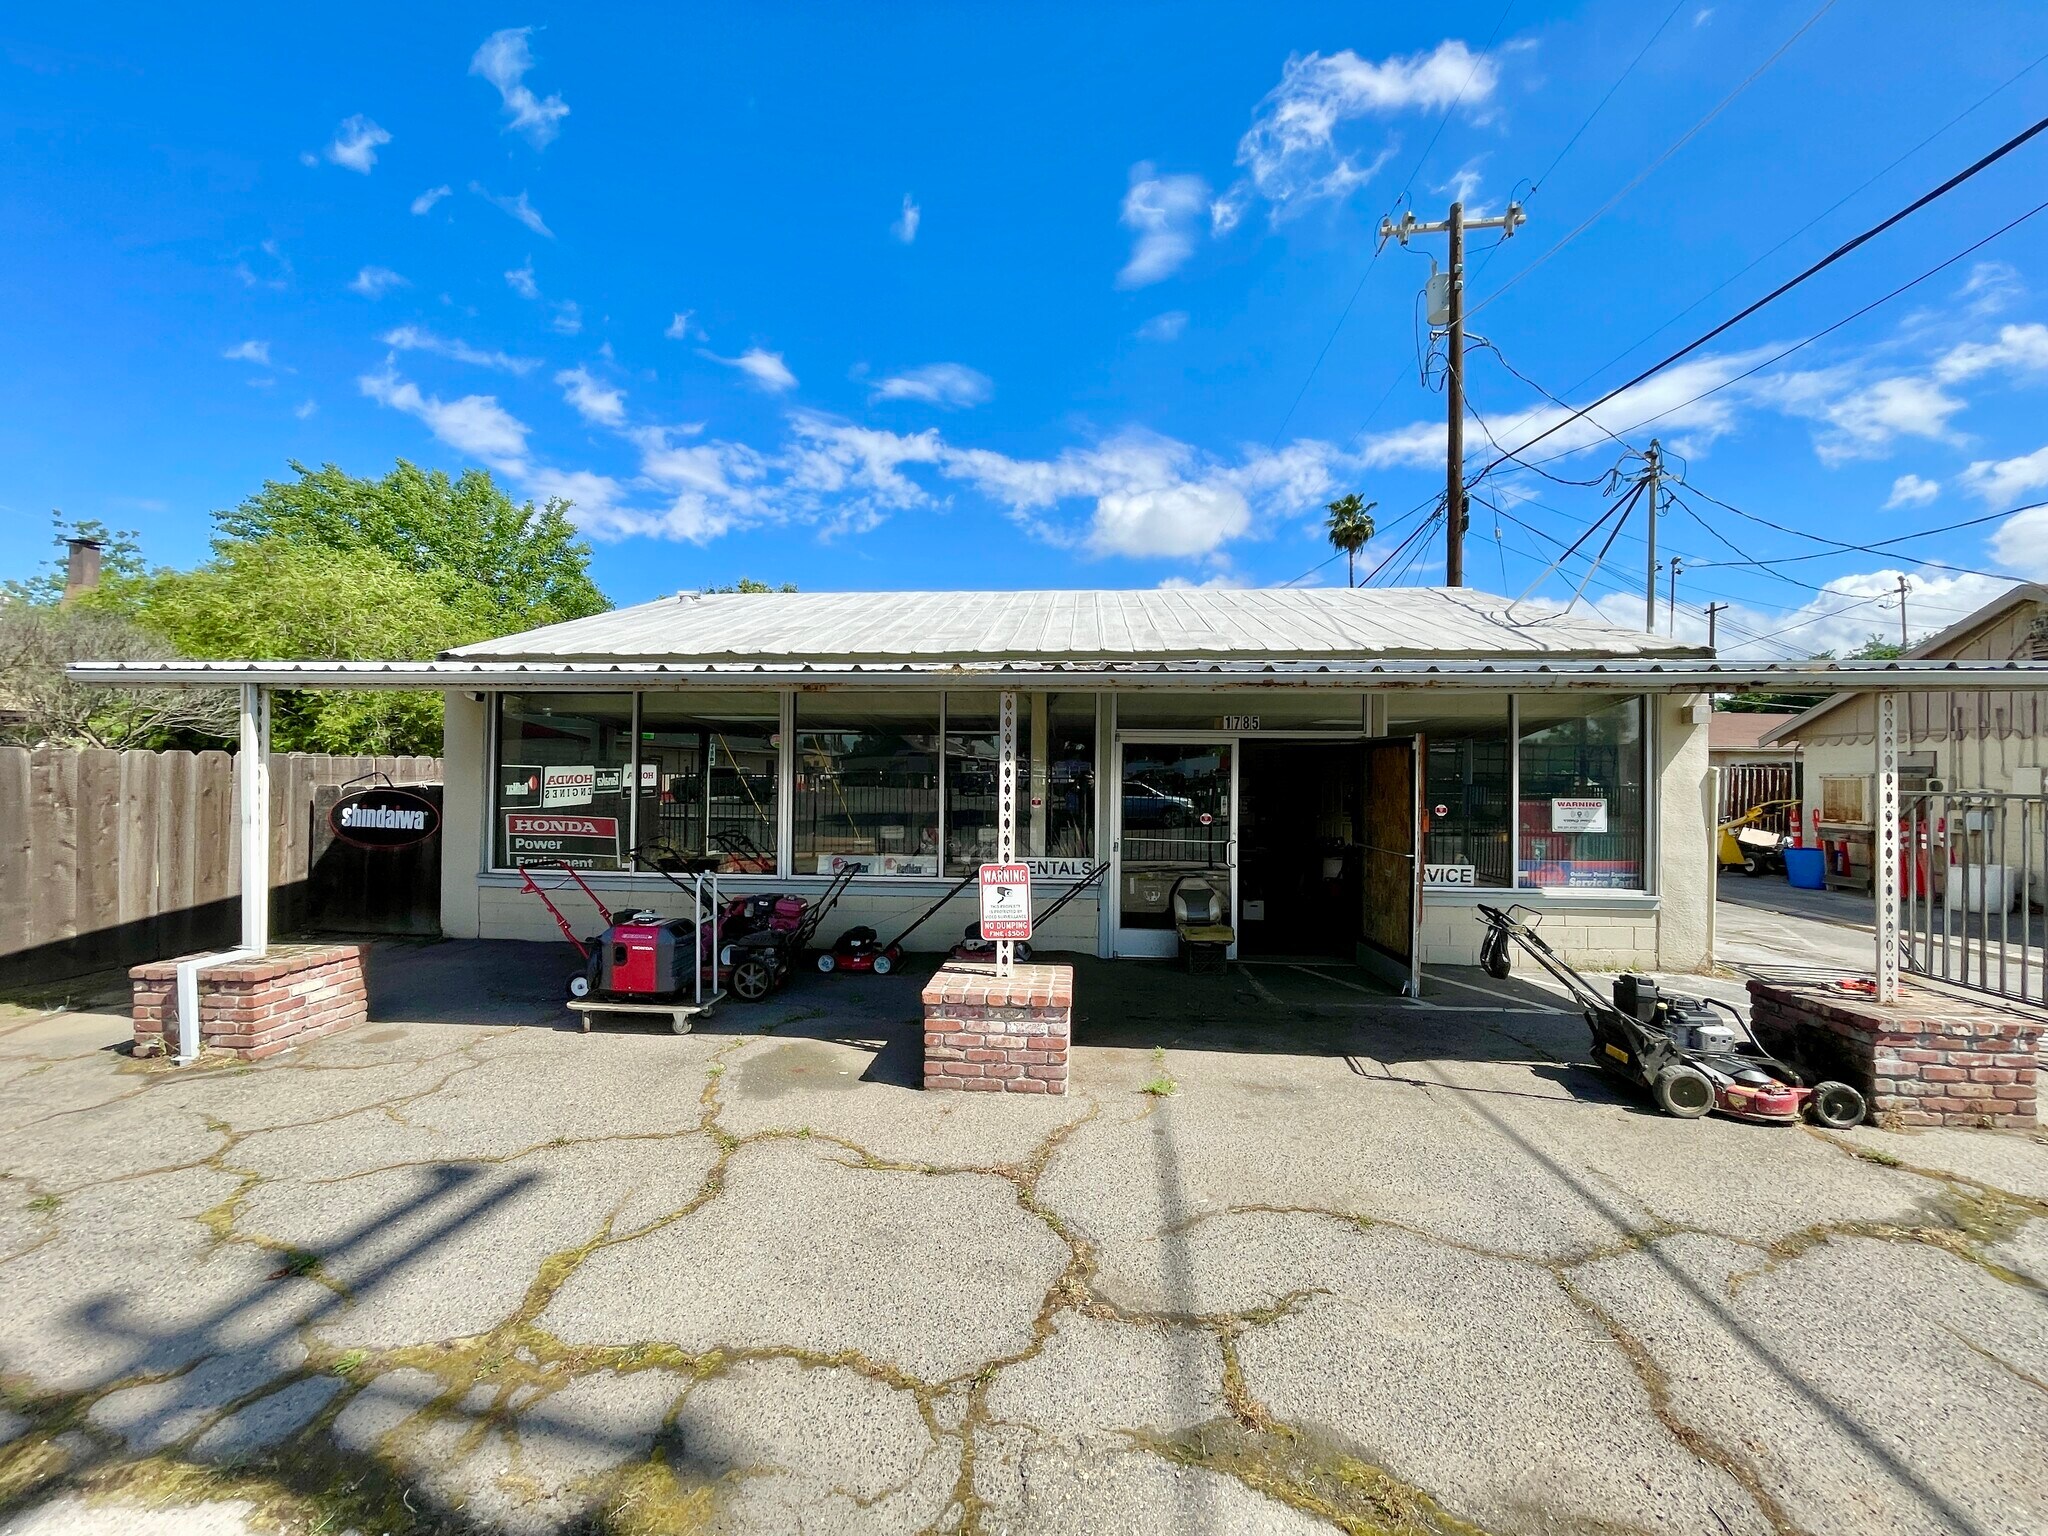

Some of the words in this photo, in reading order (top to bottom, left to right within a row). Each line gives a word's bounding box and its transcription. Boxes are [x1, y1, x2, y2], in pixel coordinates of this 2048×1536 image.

[1225, 716, 1259, 729] 1785
[341, 803, 425, 830] shindaiwa
[514, 819, 599, 834] HONDA
[515, 838, 563, 850] Power
[1016, 861, 1092, 875] ENTALS
[983, 869, 1026, 882] WARNING
[1568, 877, 1608, 887] Service
[984, 921, 995, 930] NO
[996, 921, 1028, 930] DUMPING
